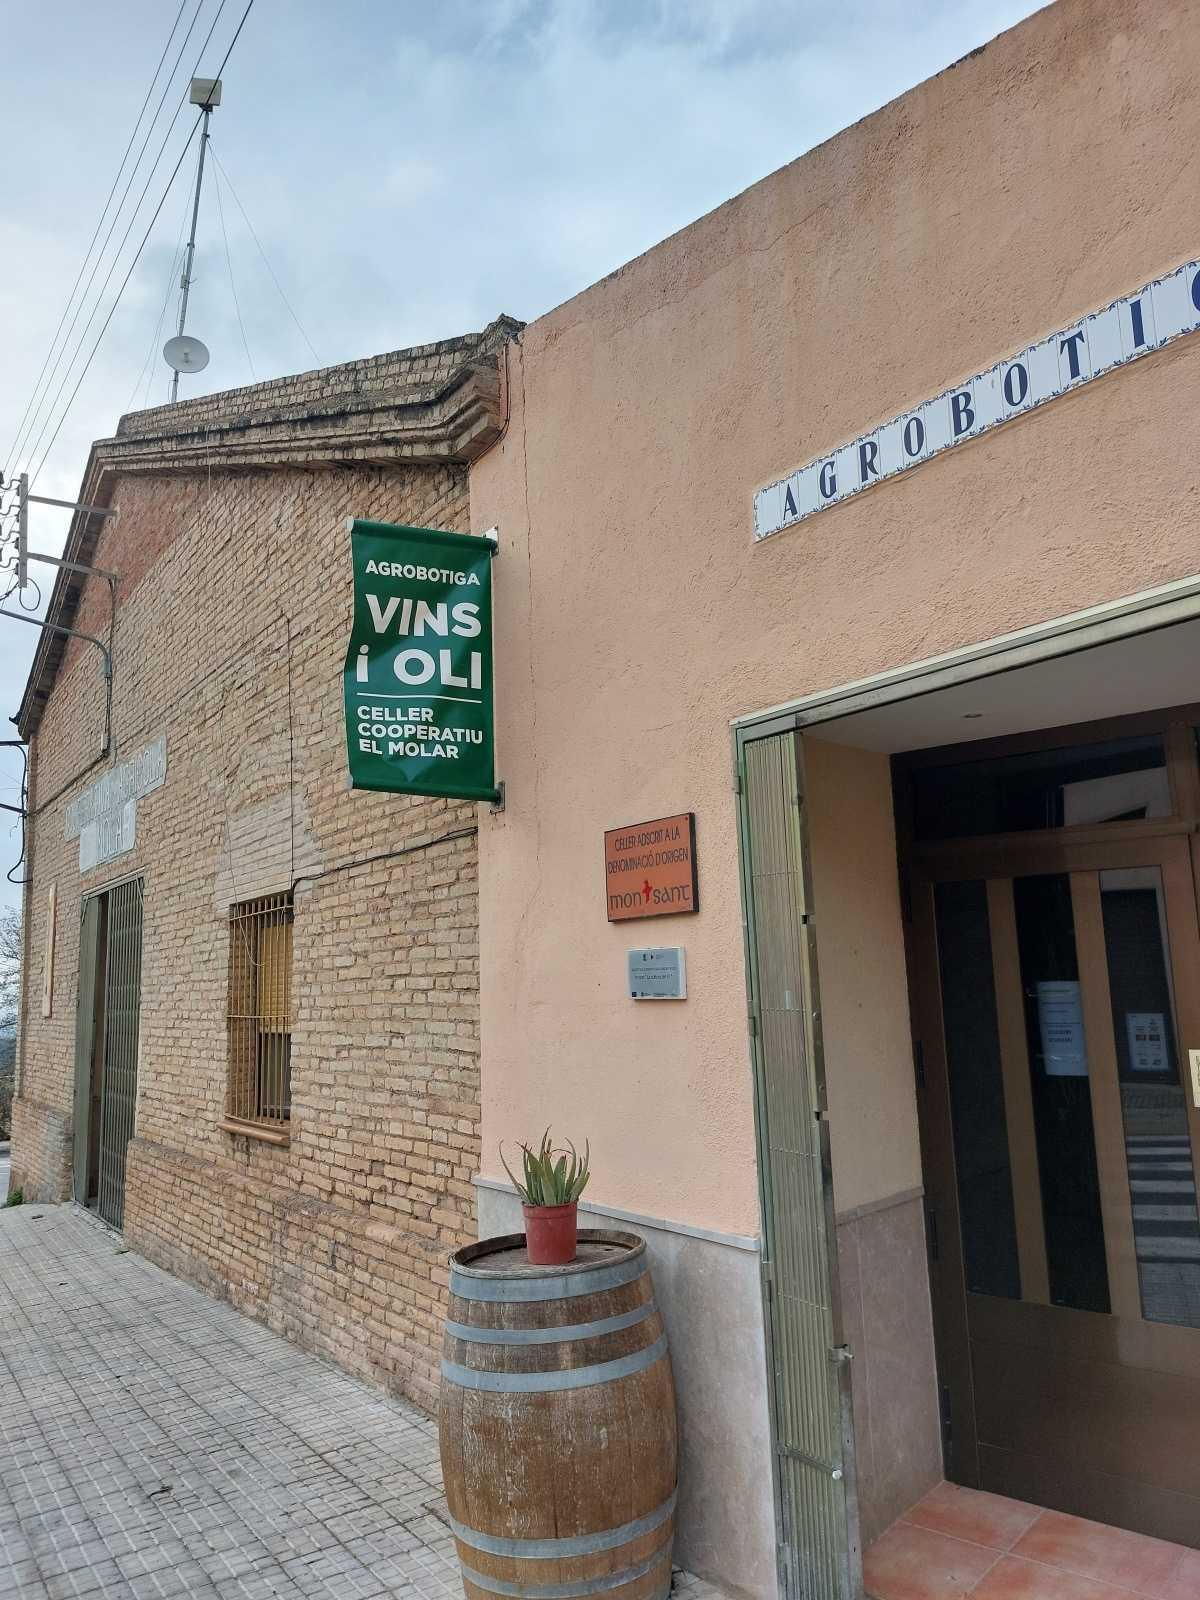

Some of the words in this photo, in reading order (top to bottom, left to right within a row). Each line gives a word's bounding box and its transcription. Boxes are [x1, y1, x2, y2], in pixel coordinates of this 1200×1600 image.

[365, 559, 480, 586] AGROBOTIGA
[365, 593, 482, 638] VINS
[356, 644, 369, 683] i
[393, 648, 482, 690] OLI
[357, 705, 434, 722] CELLER
[357, 722, 483, 744] COOPERATIU
[359, 738, 383, 755] EL
[388, 741, 459, 759] MOLAR
[614, 835, 637, 852] CELLER
[637, 829, 664, 847] ADSCRIT
[665, 827, 671, 841] A
[671, 825, 681, 840] LA
